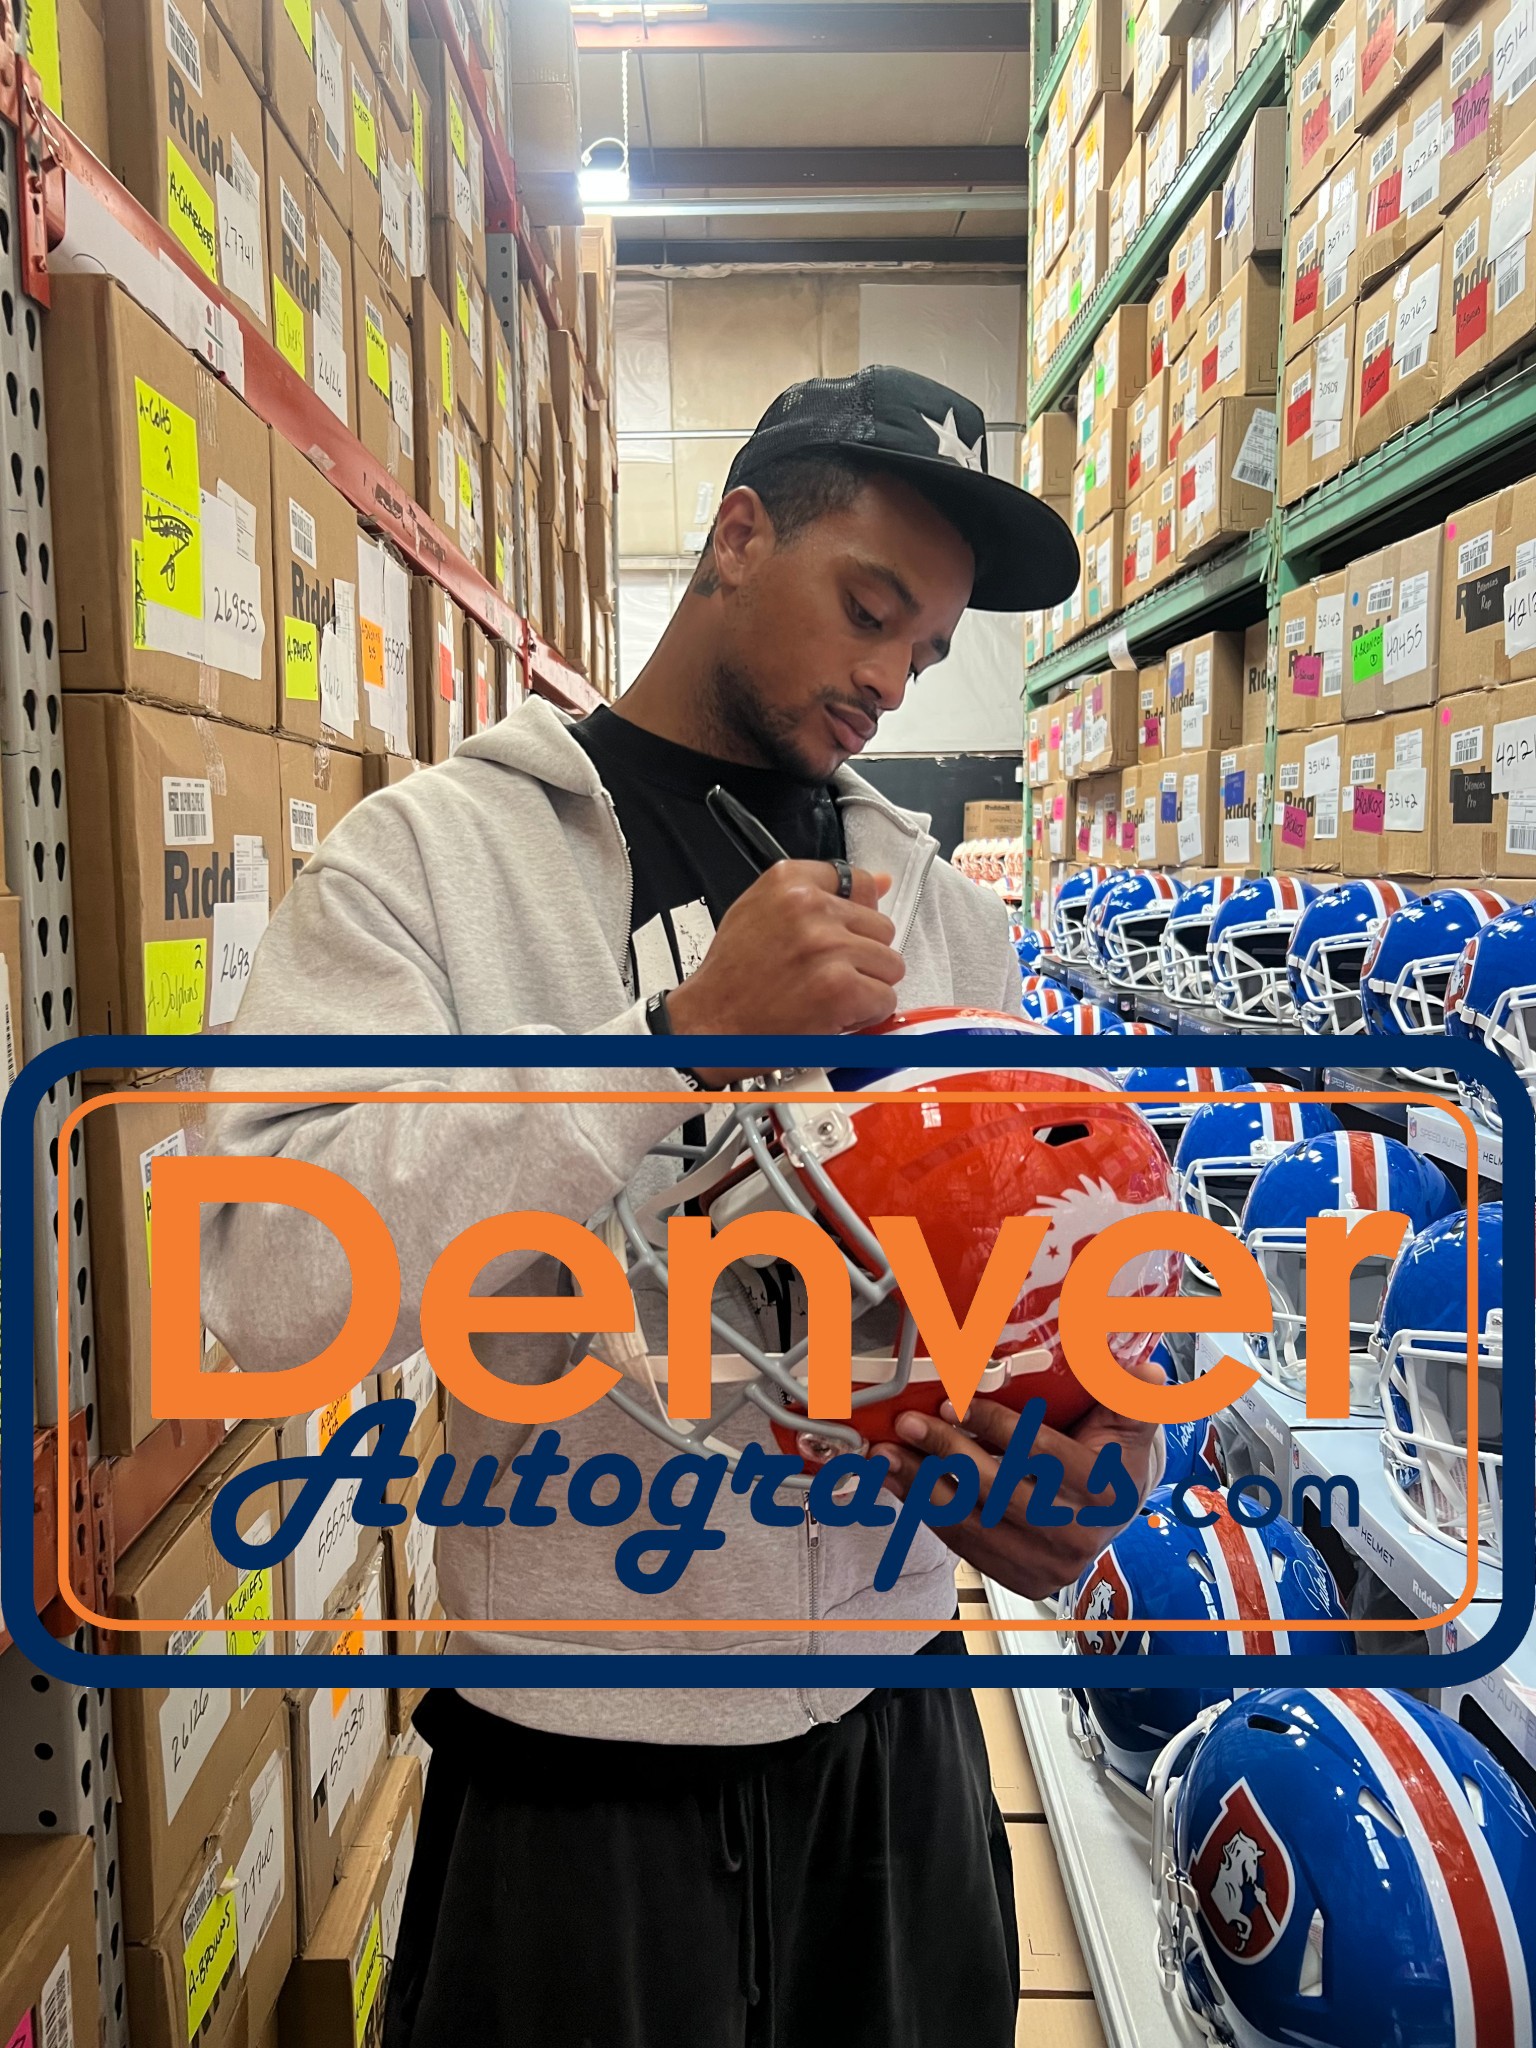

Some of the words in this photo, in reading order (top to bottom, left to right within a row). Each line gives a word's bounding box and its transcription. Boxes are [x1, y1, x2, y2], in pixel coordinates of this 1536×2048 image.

[223, 215, 255, 270] 27741
[1400, 296, 1428, 331] 30763
[318, 352, 342, 398] 26126
[214, 586, 257, 633] 26955
[1318, 611, 1341, 630] 35142
[1386, 623, 1423, 665] 49455
[1308, 757, 1331, 775] 35142
[1388, 793, 1418, 809] 35142
[1420, 1127, 1441, 1145] SPEED
[1360, 1528, 1395, 1568] HELMET
[172, 1688, 209, 1773] 26126
[329, 1693, 365, 1788] 55538
[241, 1827, 274, 1924] 27740
